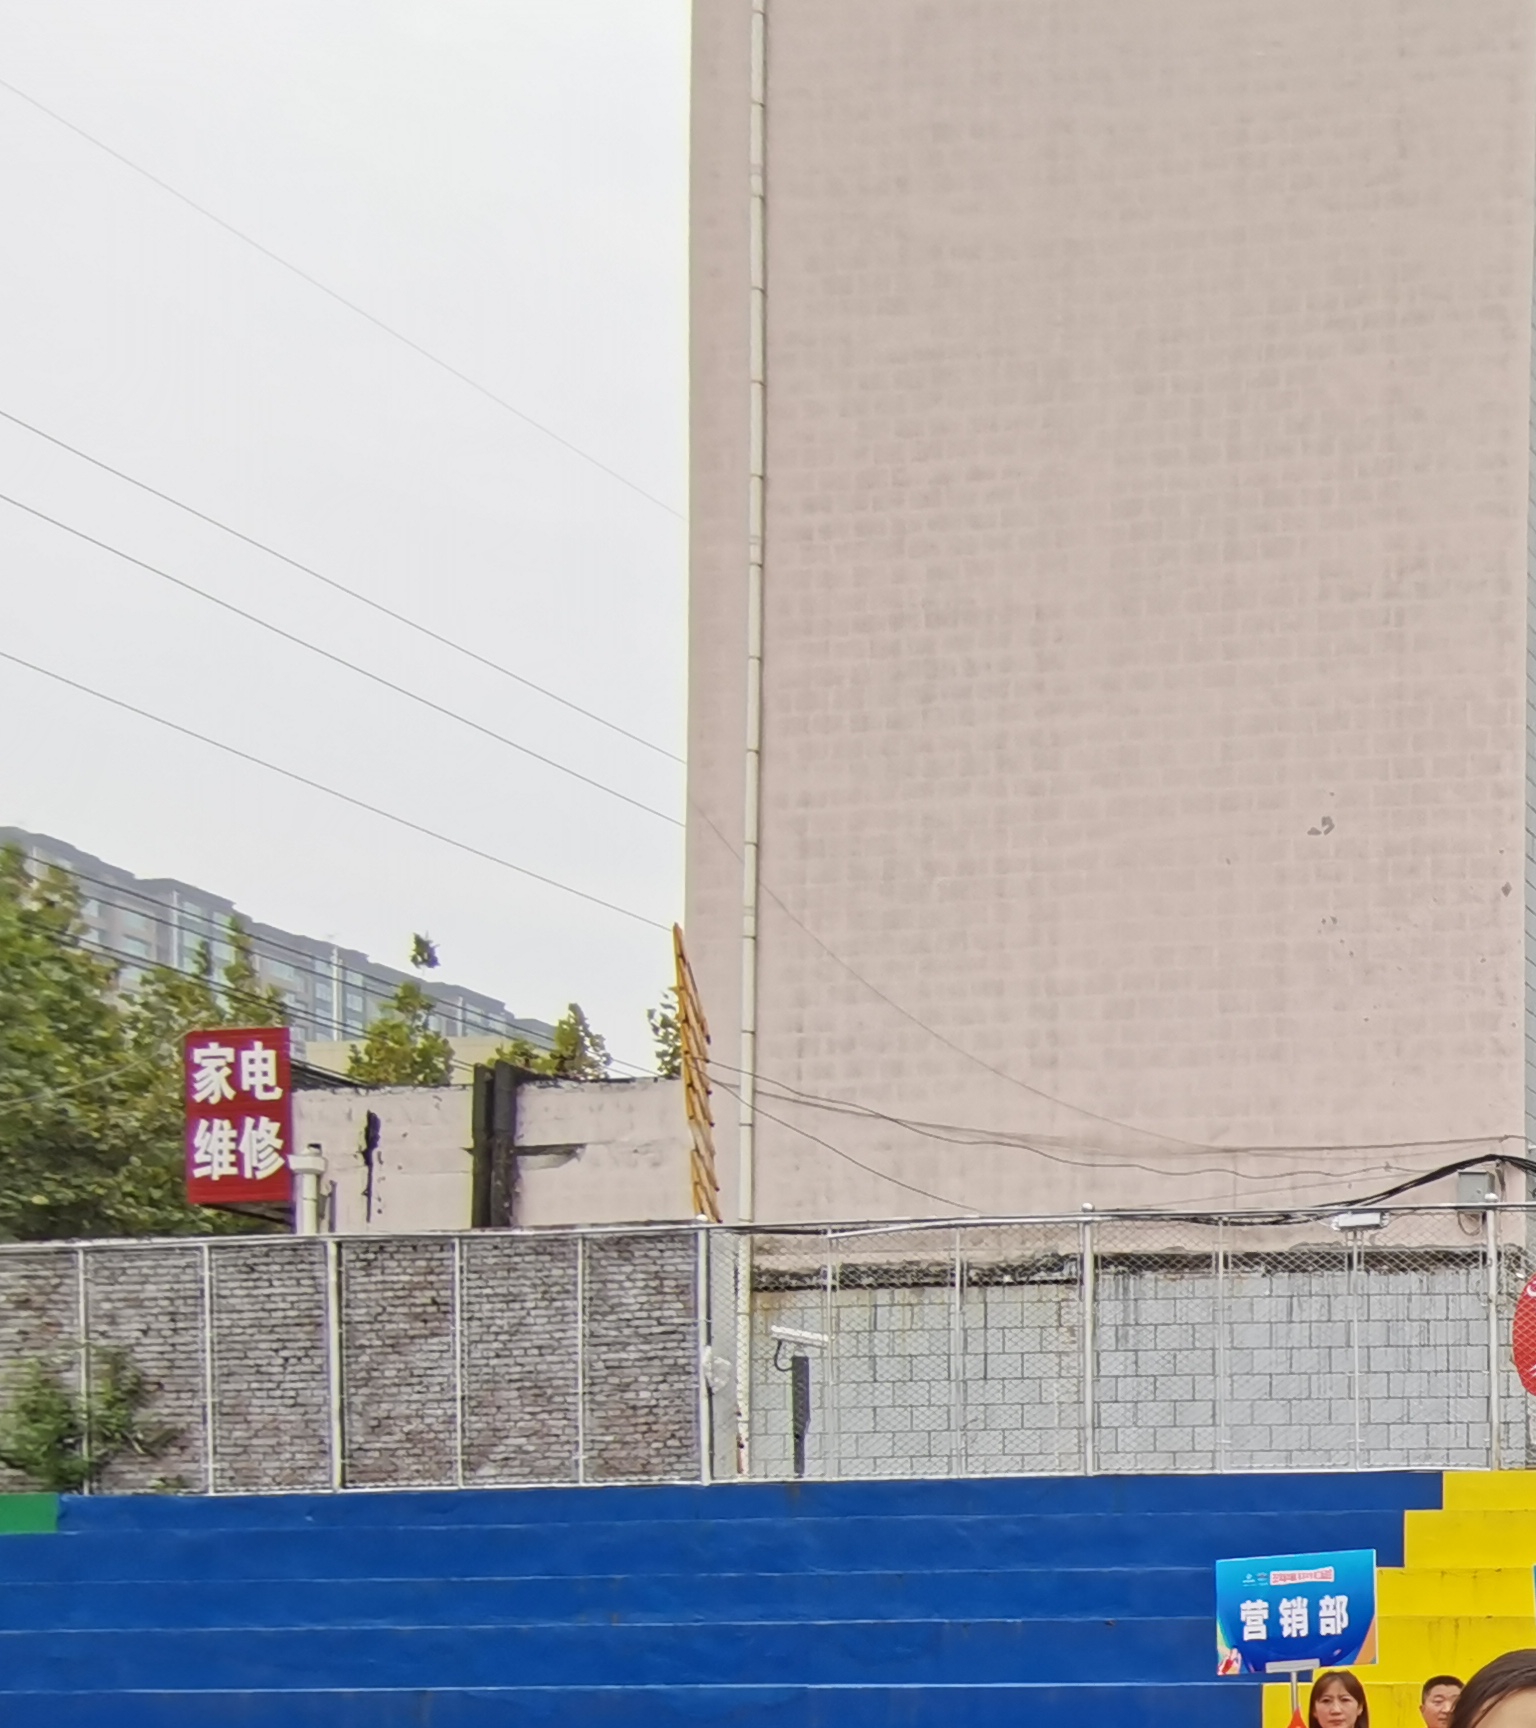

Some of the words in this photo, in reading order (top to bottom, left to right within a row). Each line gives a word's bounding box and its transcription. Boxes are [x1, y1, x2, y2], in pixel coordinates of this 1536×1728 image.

[192, 1040, 284, 1106] 家电
[192, 1115, 286, 1181] 维修
[1239, 1594, 1349, 1642] 营销部
